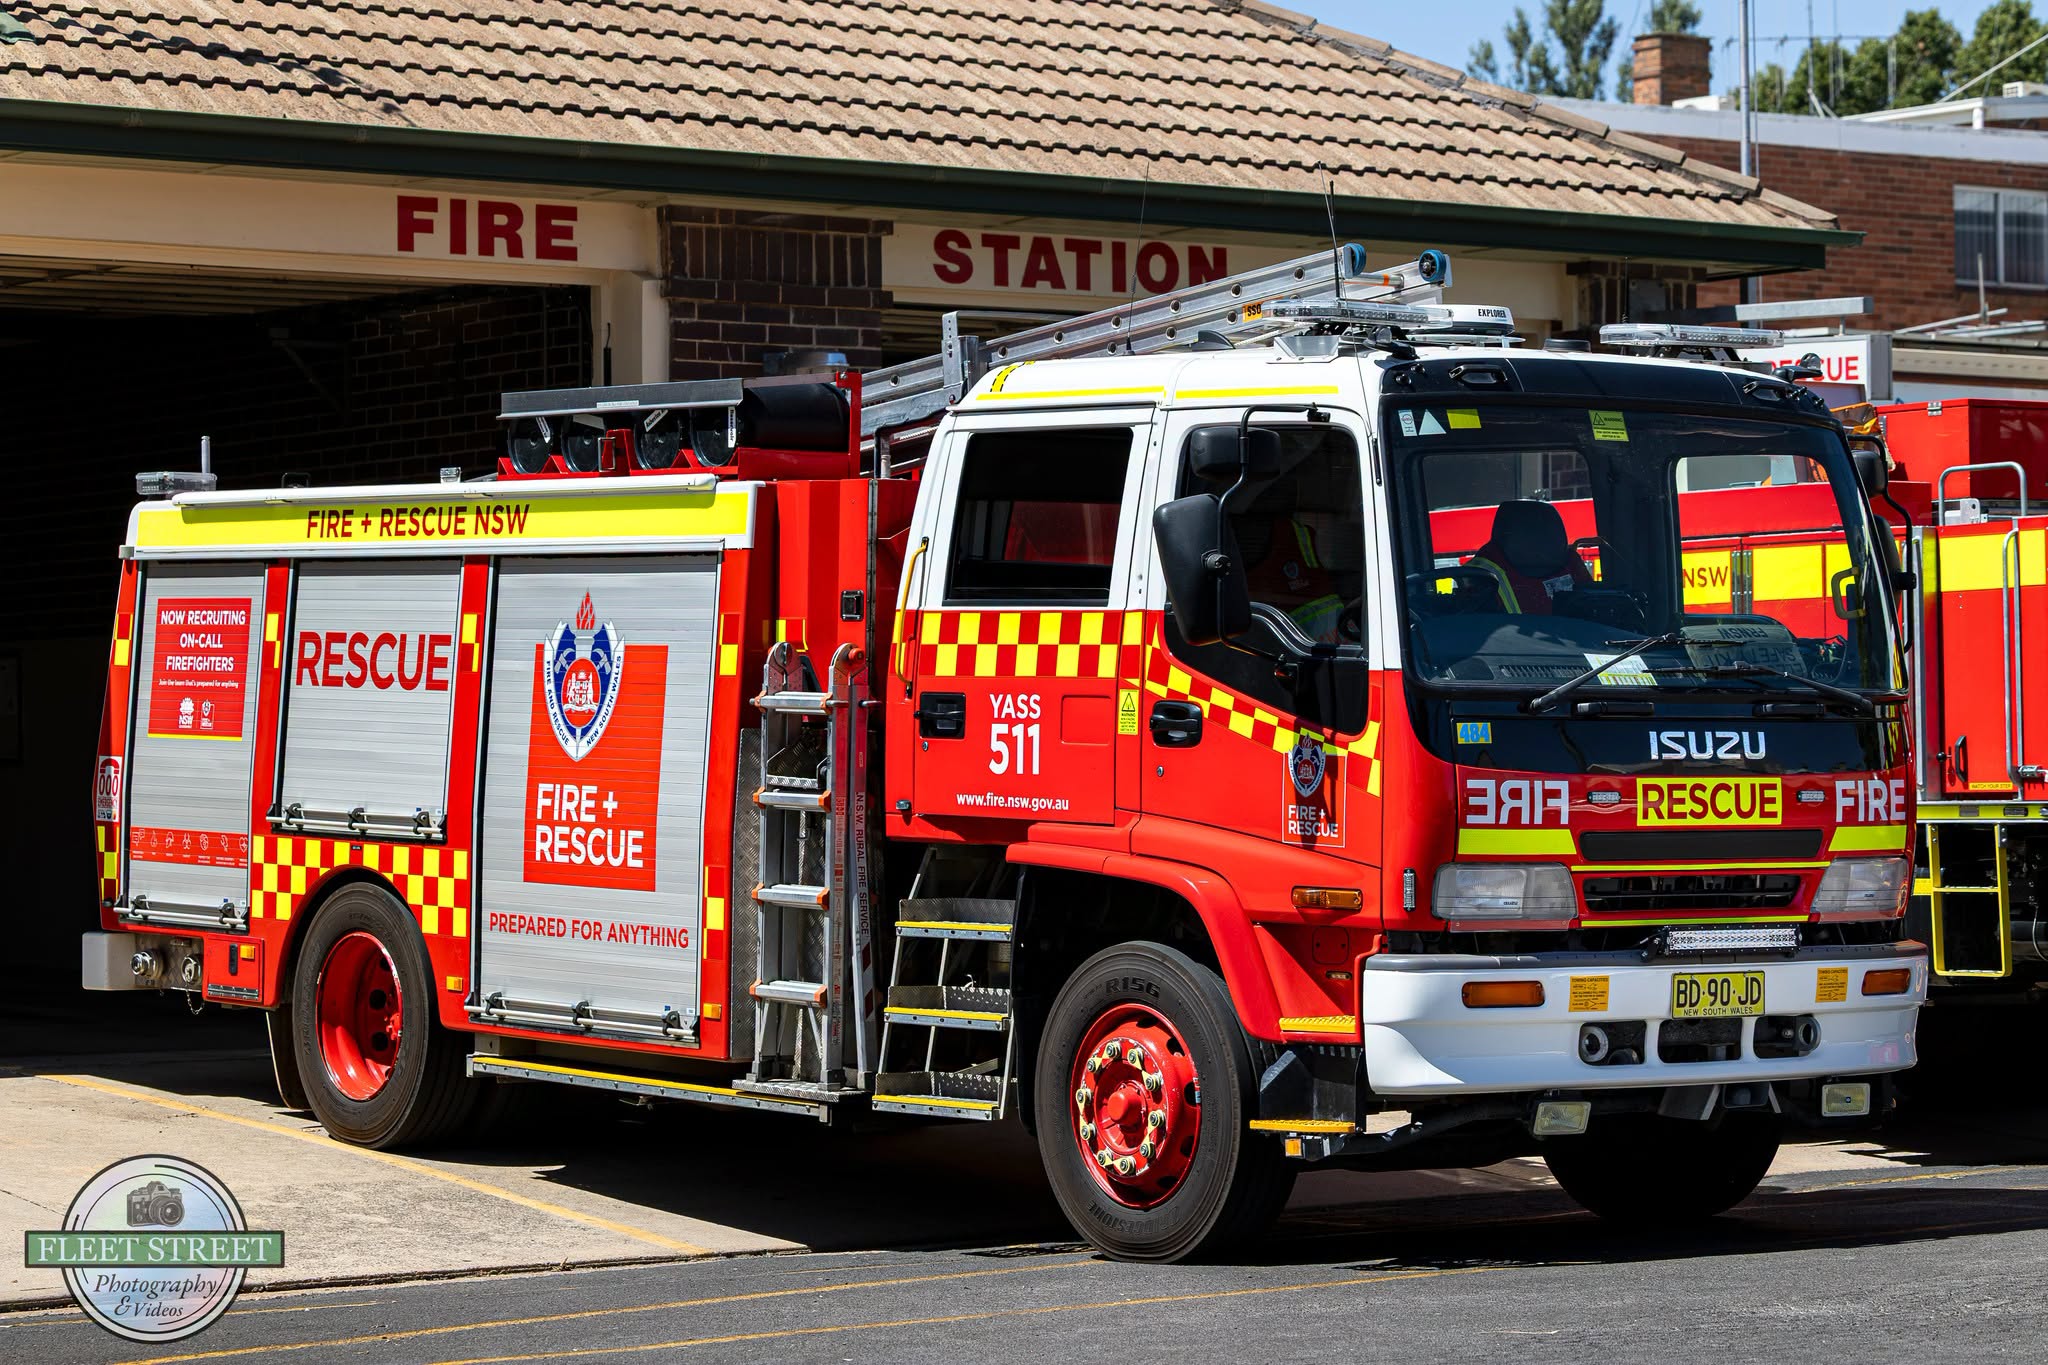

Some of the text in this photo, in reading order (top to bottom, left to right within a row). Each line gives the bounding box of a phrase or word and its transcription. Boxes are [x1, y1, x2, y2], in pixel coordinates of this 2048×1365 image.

[397, 195, 578, 261] FIRE
[933, 229, 1228, 297] STATION
[1478, 307, 1506, 319] EXPLORER
[1763, 356, 1859, 381] CUE
[307, 508, 353, 538] FIRE
[380, 506, 466, 537] RESCUE
[473, 503, 530, 535] NSW
[1682, 565, 1729, 588] NSW
[160, 610, 246, 625] NOW RECRUITING
[179, 633, 223, 648] ON-CALL
[1717, 628, 1769, 639] FRNSW
[166, 656, 234, 671] FIREFIGHTERS
[295, 631, 452, 690] RESCUE
[197, 680, 214, 688] prepared
[221, 680, 239, 689] anything
[586, 655, 622, 746] NEW SOUTH WALES
[988, 693, 1041, 720] YASS
[547, 689, 555, 709] AND
[552, 711, 570, 746] RESCUE
[1459, 723, 1491, 743] 484
[1649, 730, 1766, 760] ISUZU
[989, 723, 1040, 776] 511
[98, 774, 119, 796] 000
[536, 783, 596, 822] FIRE
[956, 791, 1070, 812] www.fire.nsw.gov.au
[1288, 804, 1317, 821] FIRE
[1641, 782, 1778, 820] RESCUE
[1836, 779, 1906, 823] FIRE
[1288, 820, 1339, 838] RESCUE
[534, 825, 643, 868] RESCUE
[855, 829, 865, 862] RURAL
[857, 866, 867, 888] FIRE
[859, 892, 869, 935] SERVICE
[489, 912, 689, 949] PREPARED FOR ANYTHING
[1684, 1007, 1754, 1016] NEW SOUTH WALES
